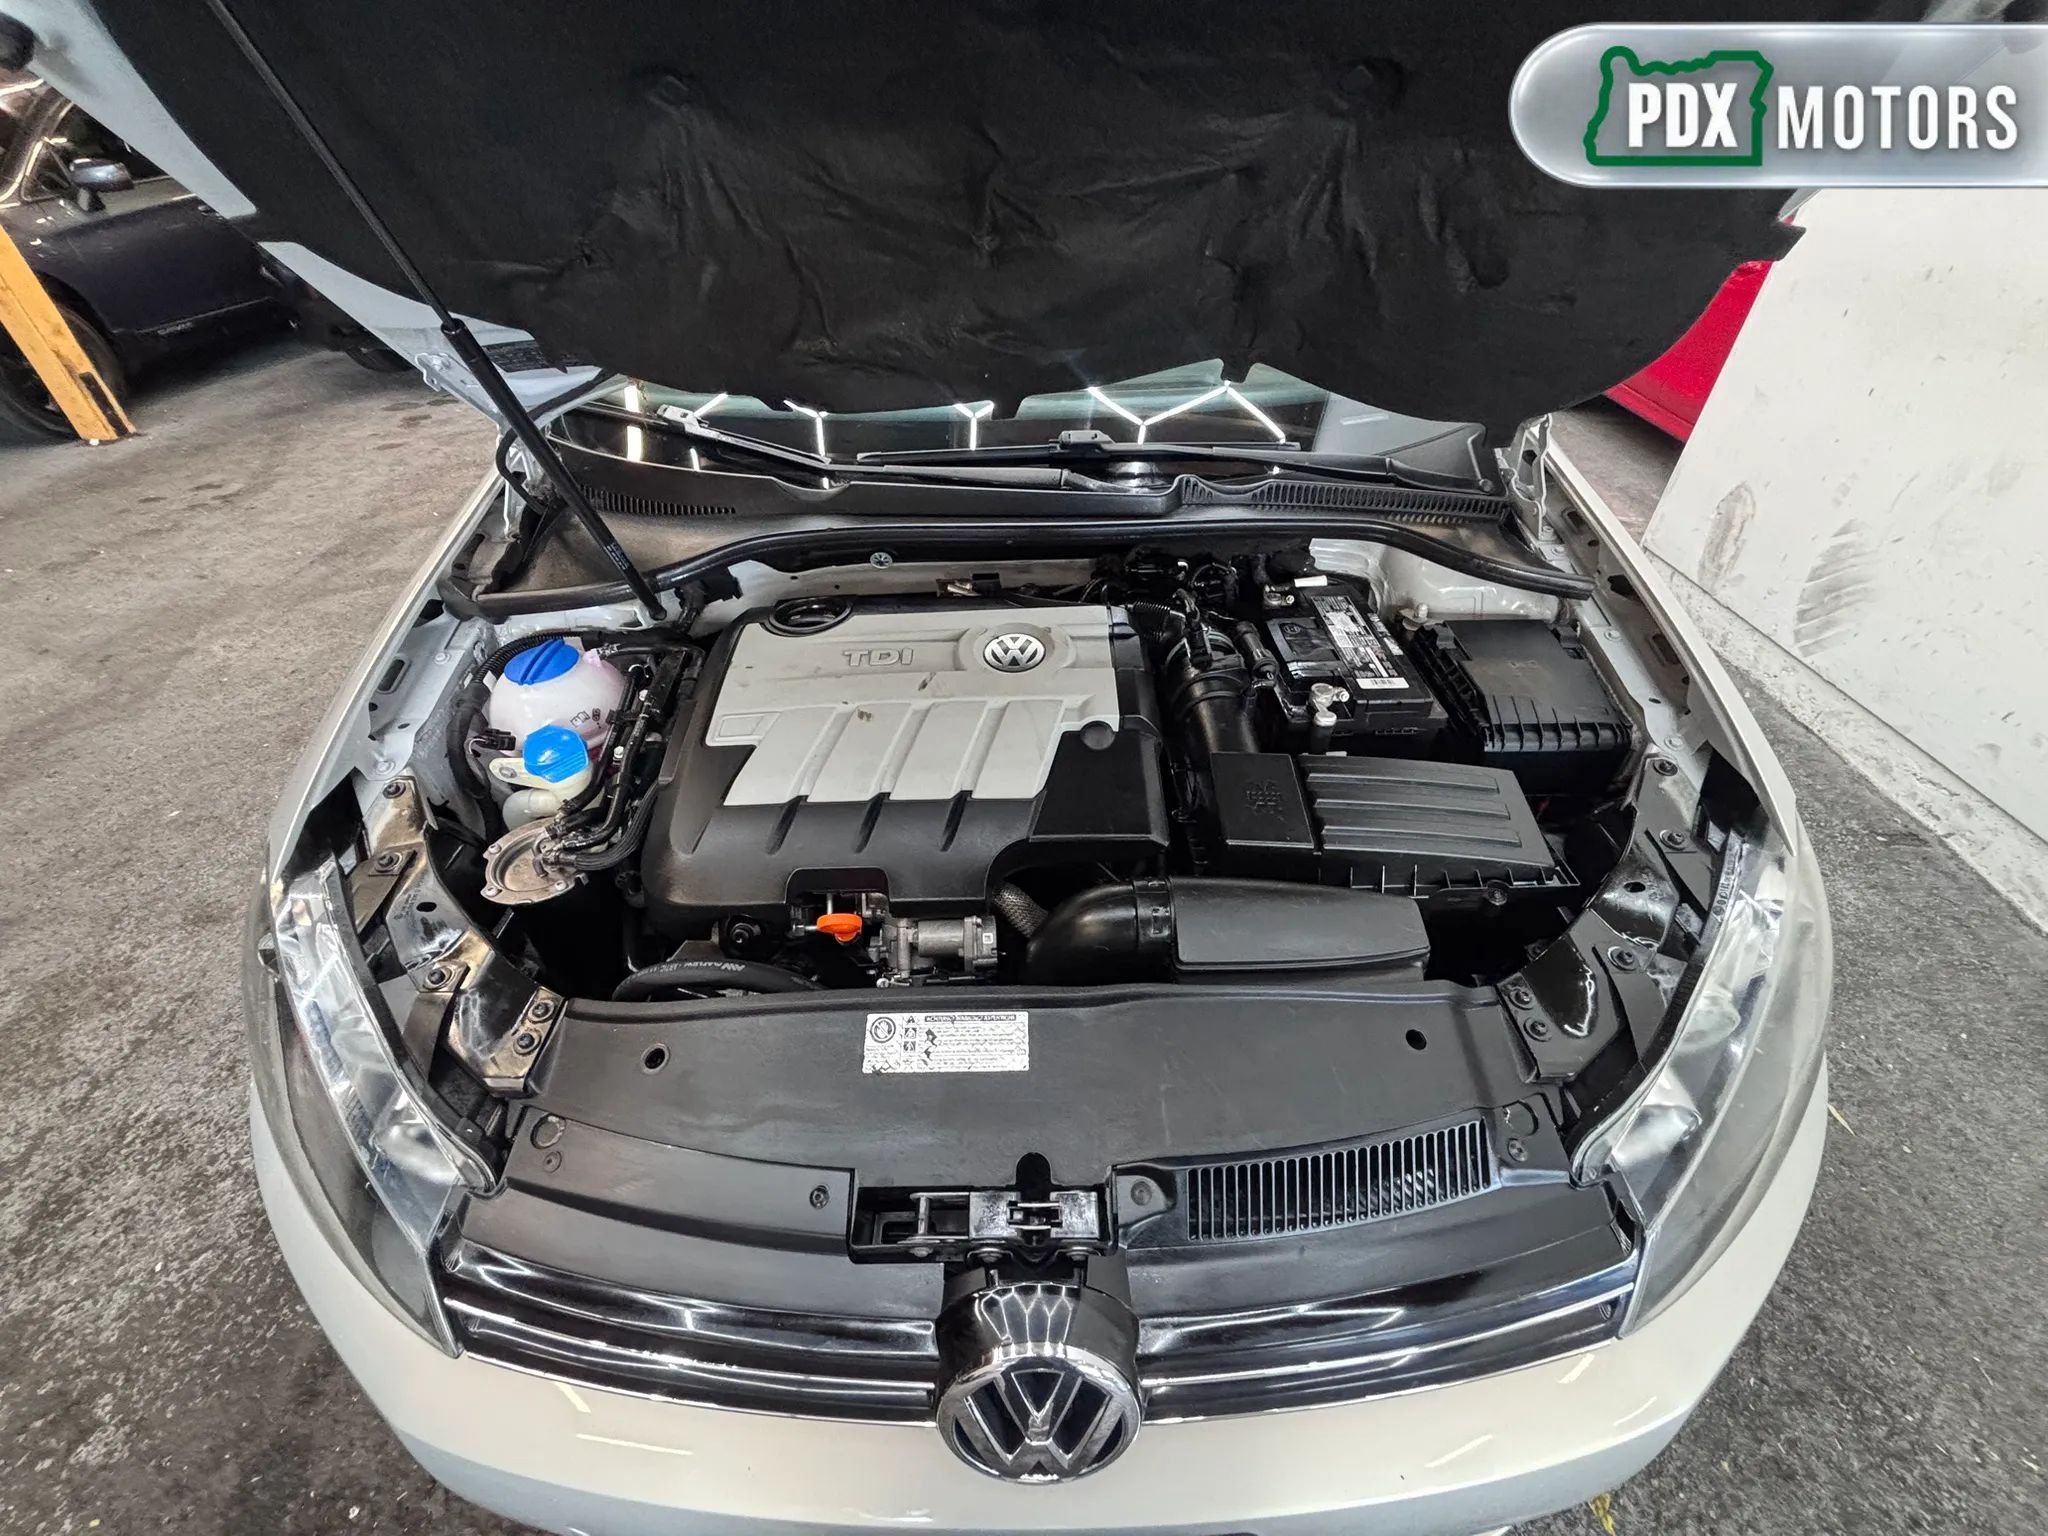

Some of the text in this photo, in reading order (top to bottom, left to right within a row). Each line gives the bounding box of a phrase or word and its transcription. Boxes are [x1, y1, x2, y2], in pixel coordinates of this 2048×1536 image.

[843, 647, 915, 667] TDI
[984, 633, 1046, 672] VW
[940, 1350, 1140, 1483] VW
